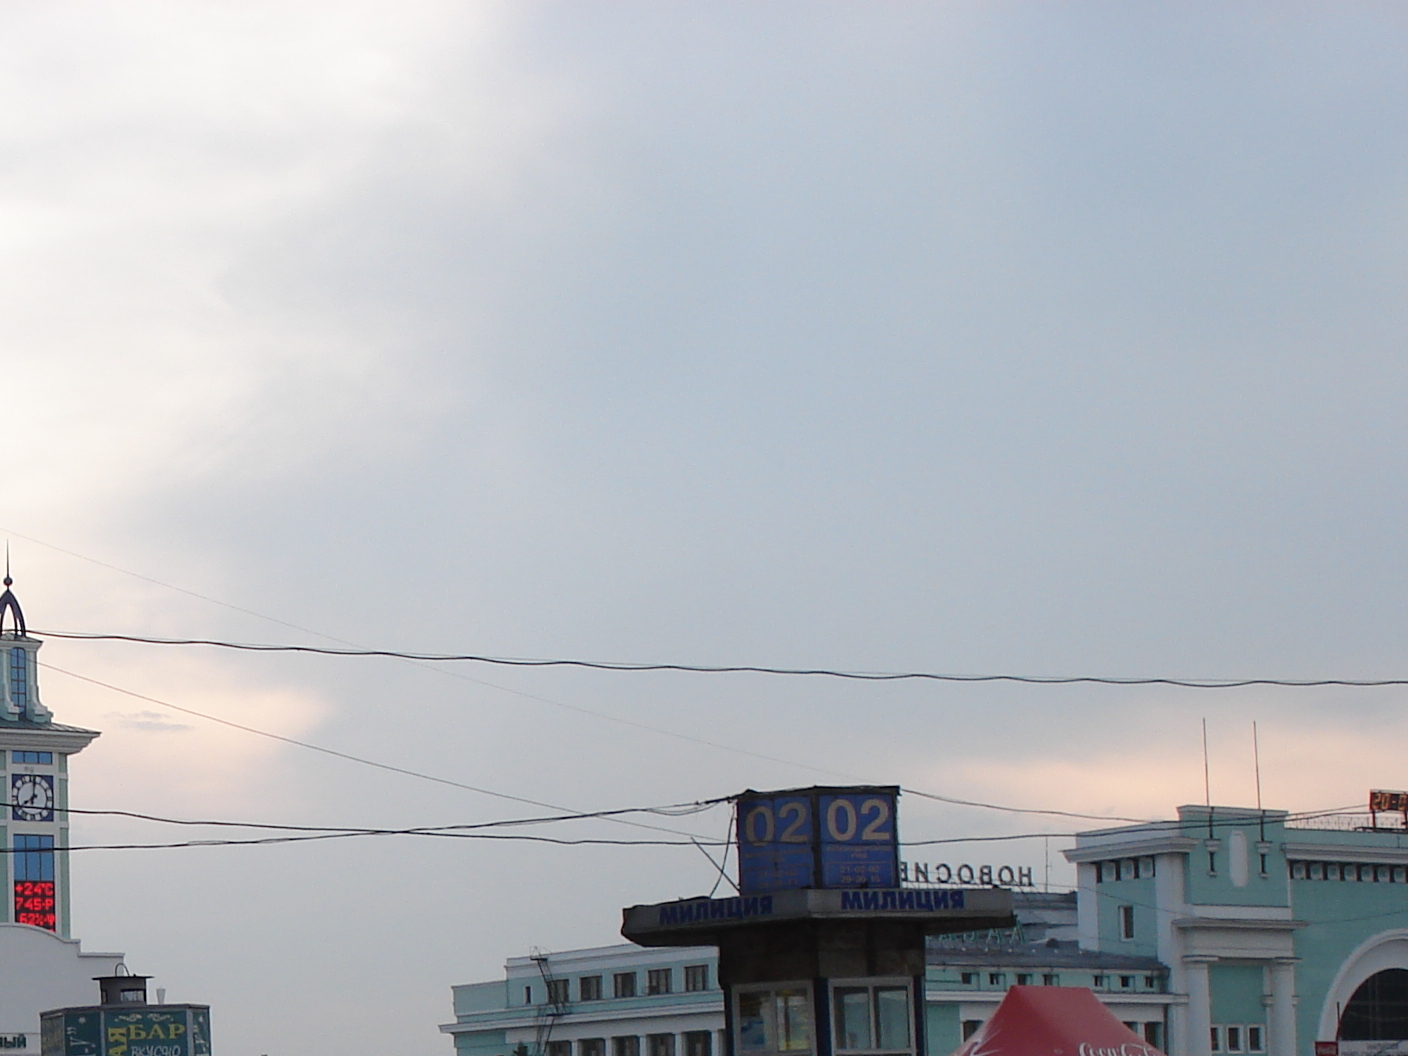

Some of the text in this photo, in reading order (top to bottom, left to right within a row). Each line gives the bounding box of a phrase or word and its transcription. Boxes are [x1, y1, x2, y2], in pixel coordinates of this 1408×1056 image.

[745, 801, 809, 847] 02
[826, 798, 891, 842] 02
[659, 896, 772, 926] МИЛИЦИЯ
[841, 890, 964, 912] МИЛИЦИЯ
[128, 1023, 186, 1040] БАР
